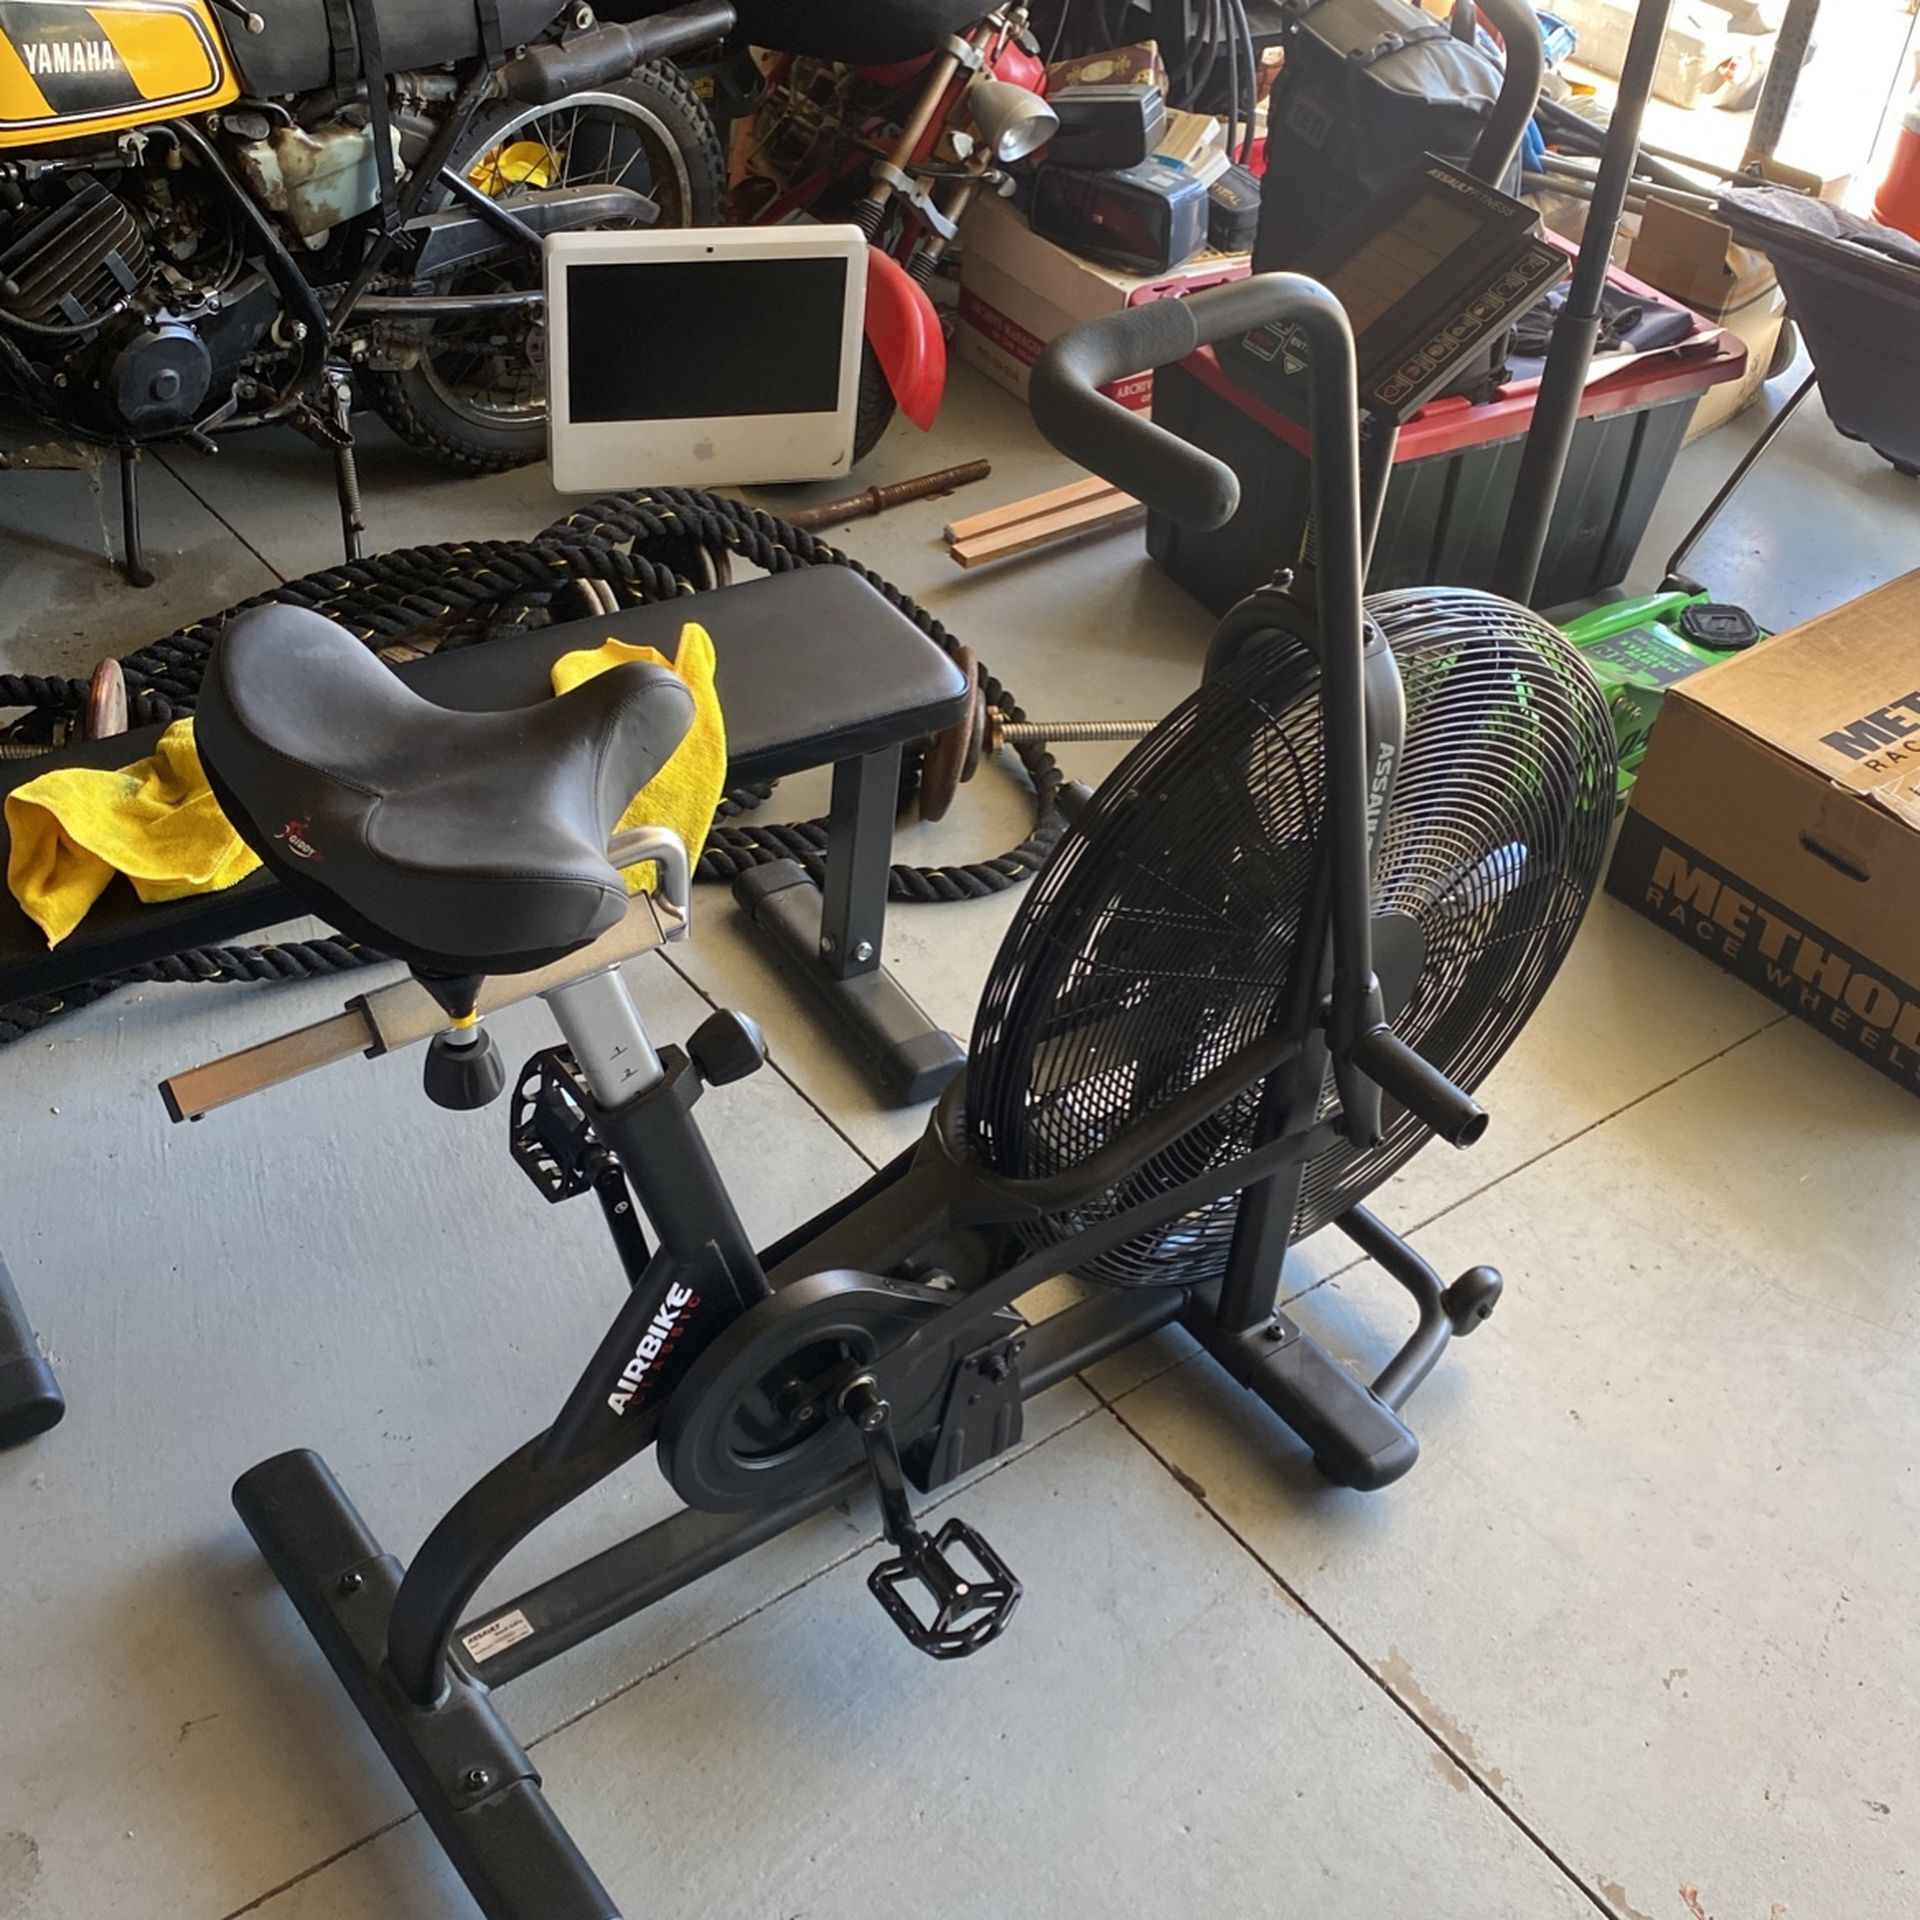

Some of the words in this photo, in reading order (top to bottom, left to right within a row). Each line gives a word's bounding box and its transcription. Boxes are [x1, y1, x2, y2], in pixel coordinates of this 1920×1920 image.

[22, 41, 115, 74] YAMAHA
[1646, 886, 1742, 958] RACE
[607, 1281, 693, 1416] AIRBIKE
[632, 1296, 700, 1405] CLASSIC
